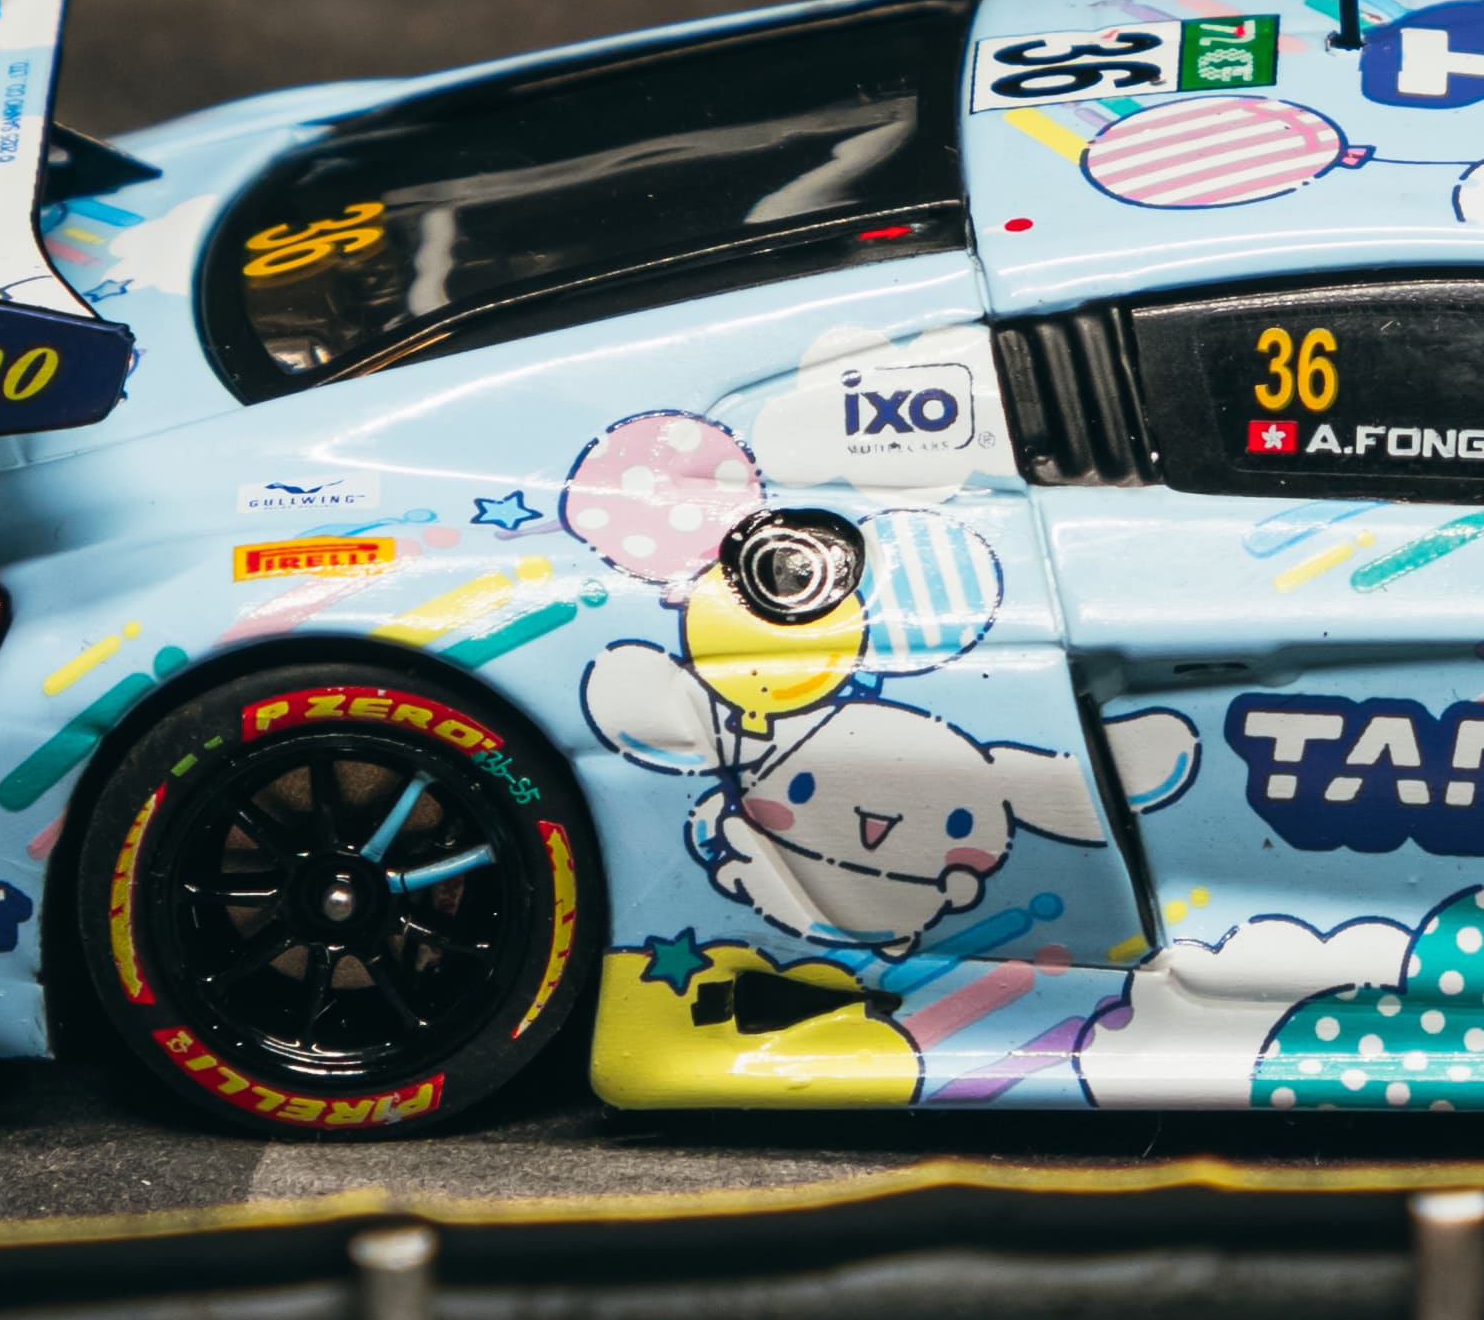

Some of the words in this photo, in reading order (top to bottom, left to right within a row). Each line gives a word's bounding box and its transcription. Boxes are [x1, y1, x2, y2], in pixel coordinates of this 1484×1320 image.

[991, 32, 1163, 97] 36
[243, 202, 385, 276] 36
[1254, 327, 1339, 411] 36
[841, 369, 959, 435] ixo
[248, 495, 355, 507] GULLWING
[246, 542, 380, 573] PIRELLI
[255, 700, 289, 731] P
[186, 1053, 436, 1125] PIRELLI
